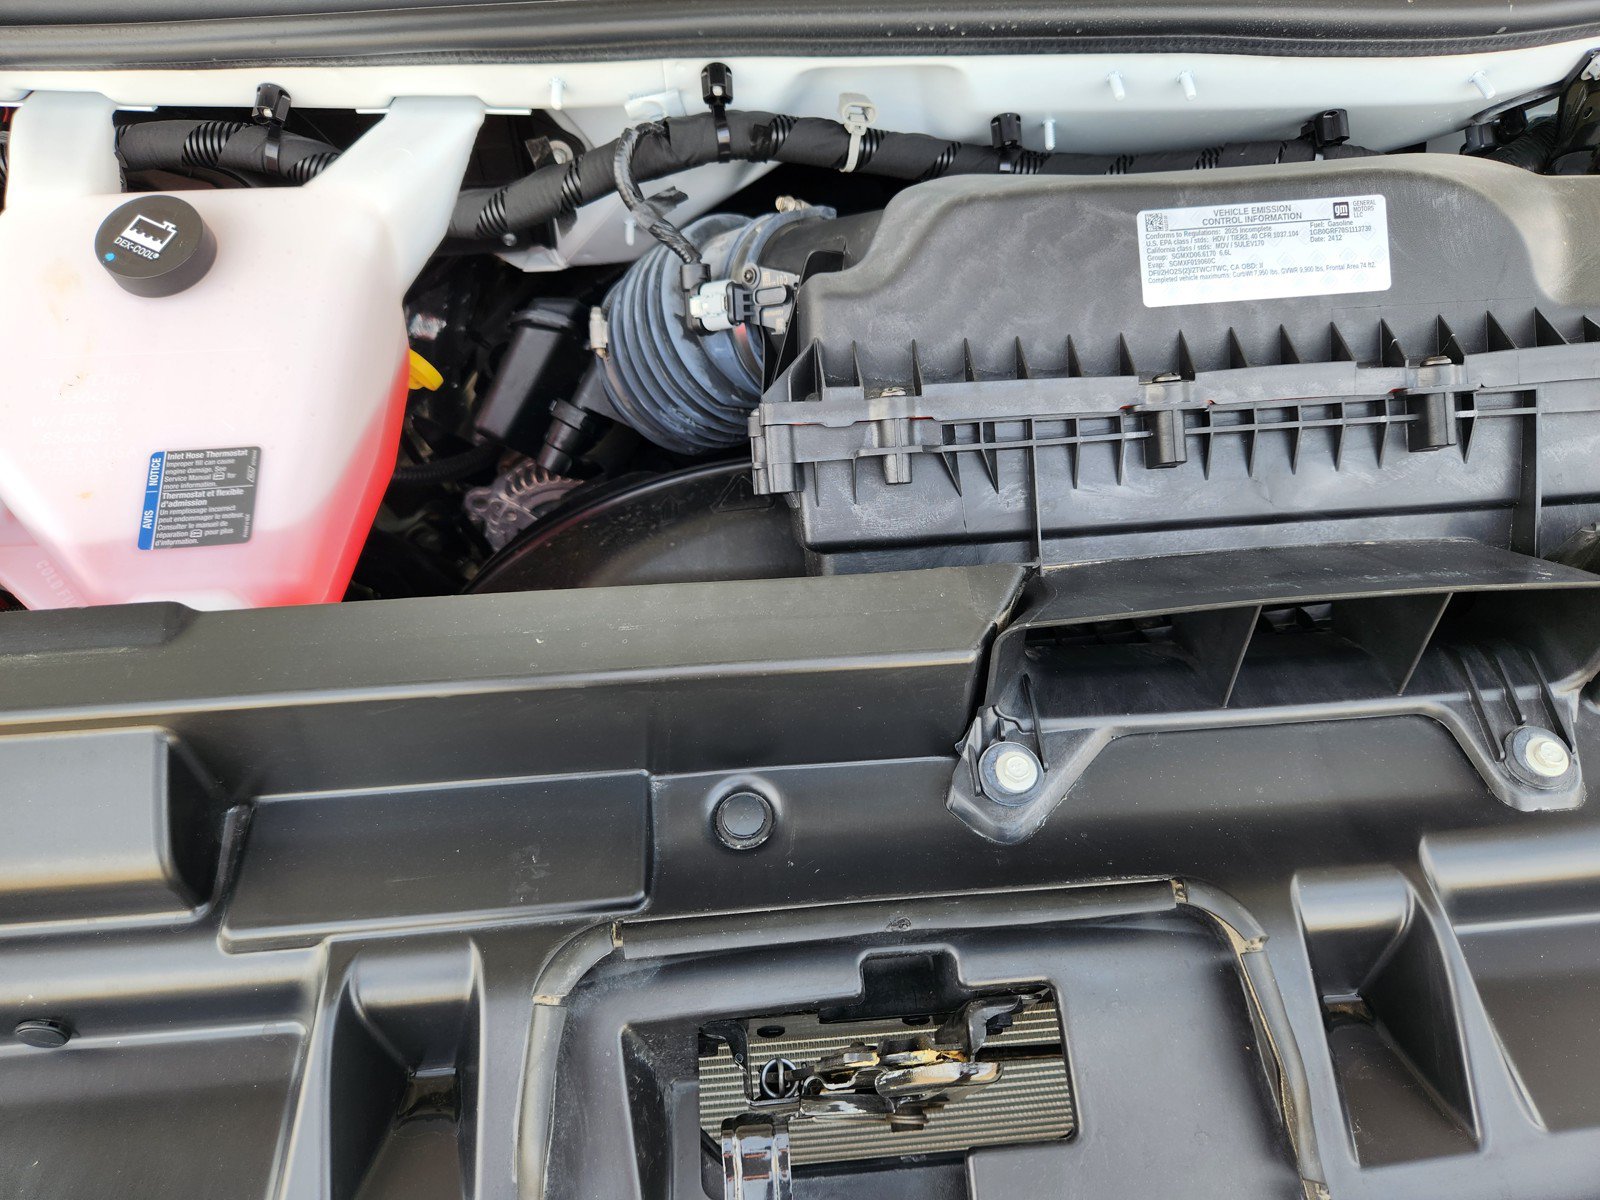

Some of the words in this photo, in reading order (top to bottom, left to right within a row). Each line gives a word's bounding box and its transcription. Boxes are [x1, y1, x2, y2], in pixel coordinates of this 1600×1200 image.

[1214, 207, 1250, 217] VEHICLE
[1251, 205, 1292, 214] EMISSION
[1334, 205, 1348, 216] gm
[1202, 216, 1243, 226] CONTROL
[1245, 212, 1302, 223] INFORMATION
[1145, 232, 1175, 240] Conforms
[1184, 229, 1221, 237] Regulations:
[1240, 225, 1272, 234] Incomplete
[1147, 246, 1175, 254] California
[1148, 261, 1165, 269] Evap:
[1148, 275, 1177, 284] Completed
[1179, 274, 1198, 282] vehicle
[1326, 264, 1345, 272] Frontal
[1346, 263, 1359, 271] Area
[206, 449, 248, 458] Thermostat
[166, 460, 194, 468] Improper
[149, 458, 161, 486] NOTICE
[162, 491, 206, 499] Thermostat
[161, 499, 208, 508] d'admission
[169, 507, 208, 515] remplissage
[209, 505, 236, 513] incorrect
[143, 510, 153, 530] AVIS
[157, 523, 187, 531] Consulter
[155, 538, 199, 546] d'information.
